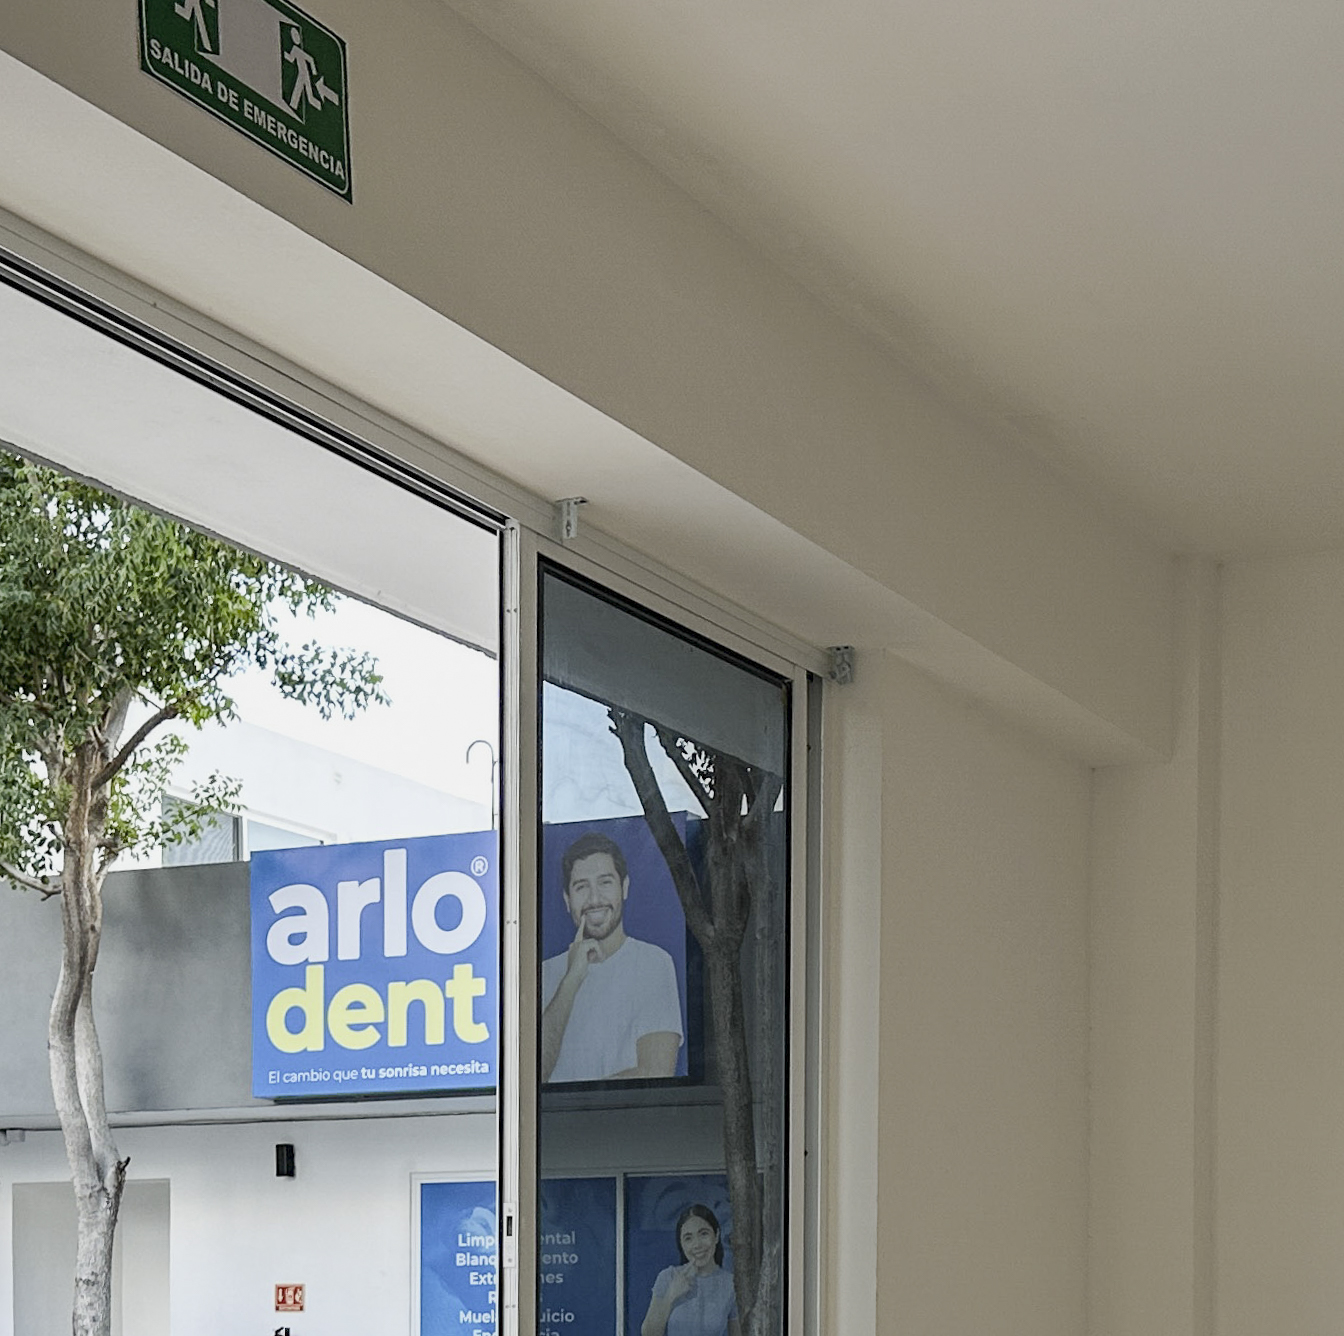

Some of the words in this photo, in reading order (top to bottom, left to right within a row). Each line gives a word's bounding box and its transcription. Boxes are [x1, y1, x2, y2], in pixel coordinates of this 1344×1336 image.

[149, 39, 213, 95] SALIDA
[217, 81, 240, 112] DE
[243, 98, 345, 180] EMERGENCIA
[265, 963, 490, 1054] dent
[268, 1071, 280, 1084] El
[282, 1068, 331, 1084] cambio
[333, 1070, 359, 1084] que
[361, 1067, 376, 1080] tu
[378, 1063, 428, 1079] sonrisa
[430, 1060, 490, 1077] necesita
